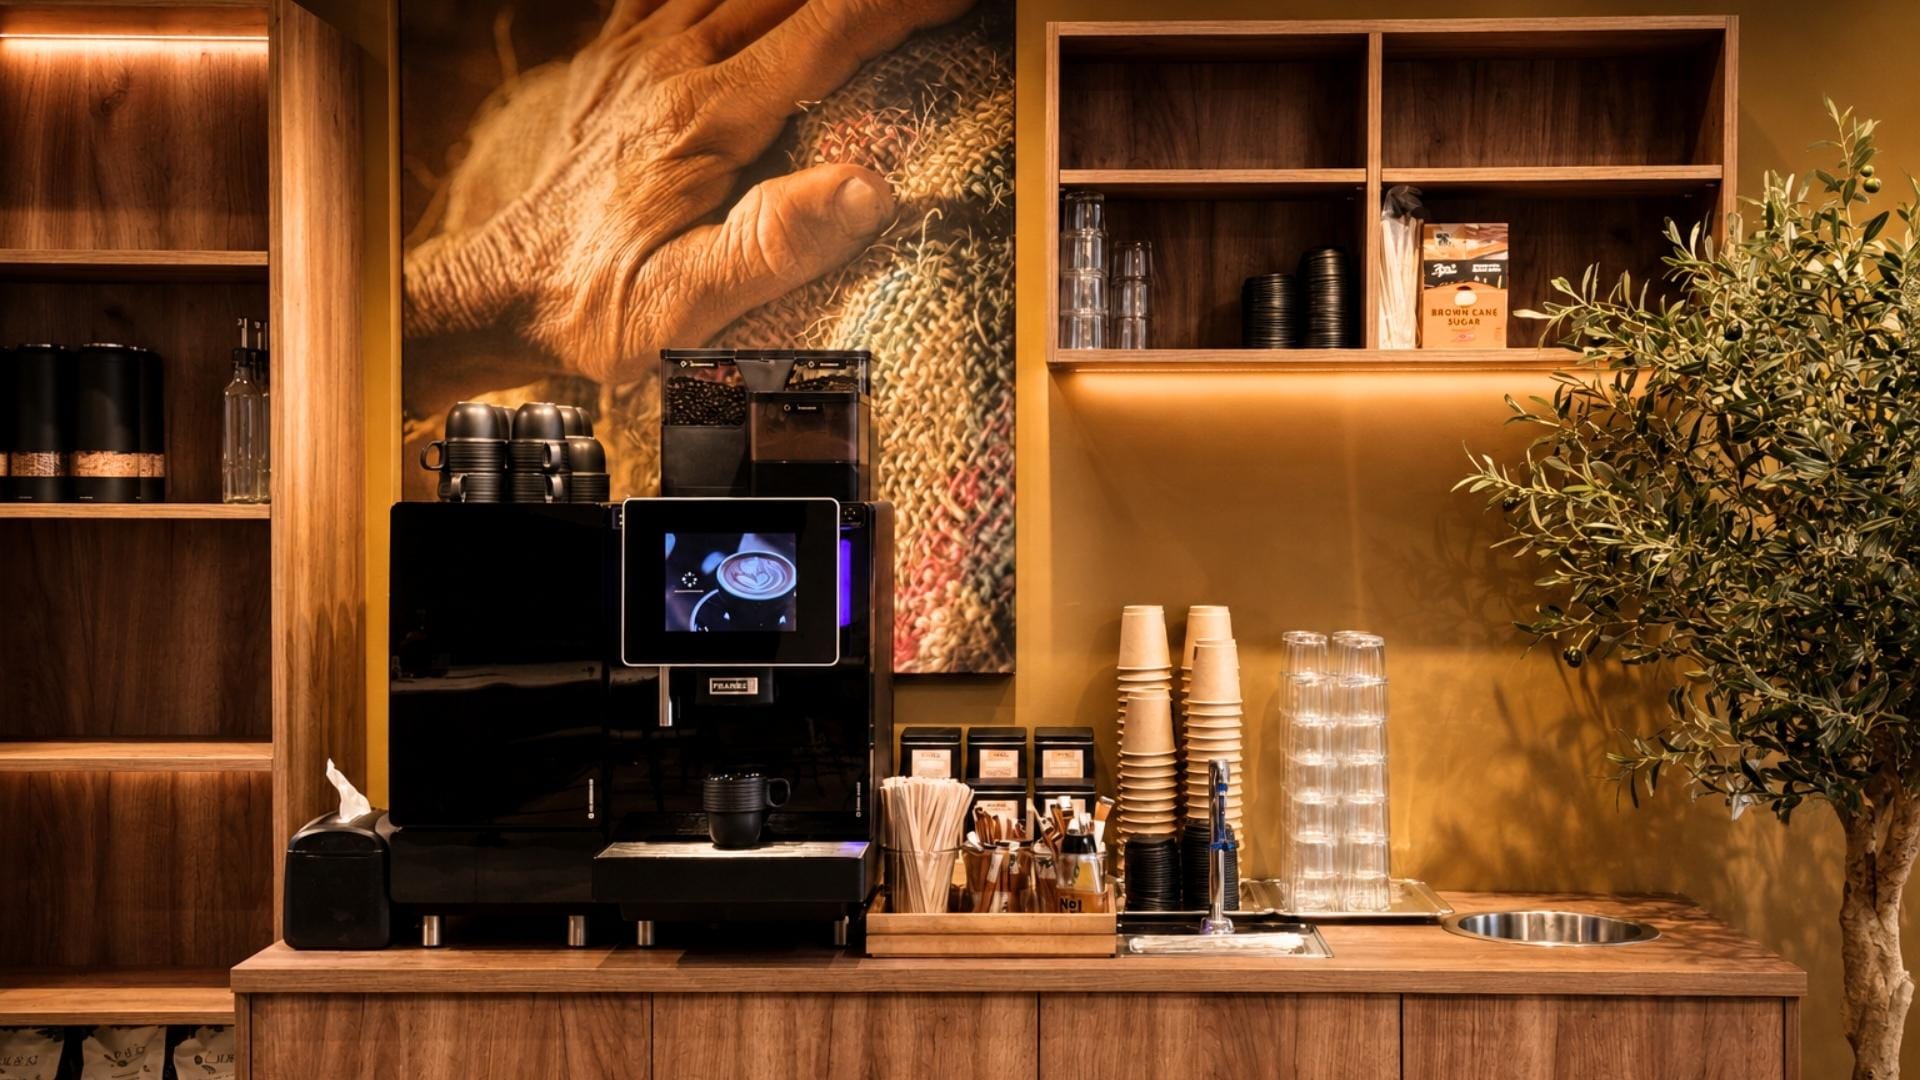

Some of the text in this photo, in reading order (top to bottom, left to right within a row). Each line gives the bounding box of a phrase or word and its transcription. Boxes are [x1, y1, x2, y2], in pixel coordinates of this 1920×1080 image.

[1431, 308, 1498, 317] BROWN CANE
[1448, 318, 1481, 326] SUGAR
